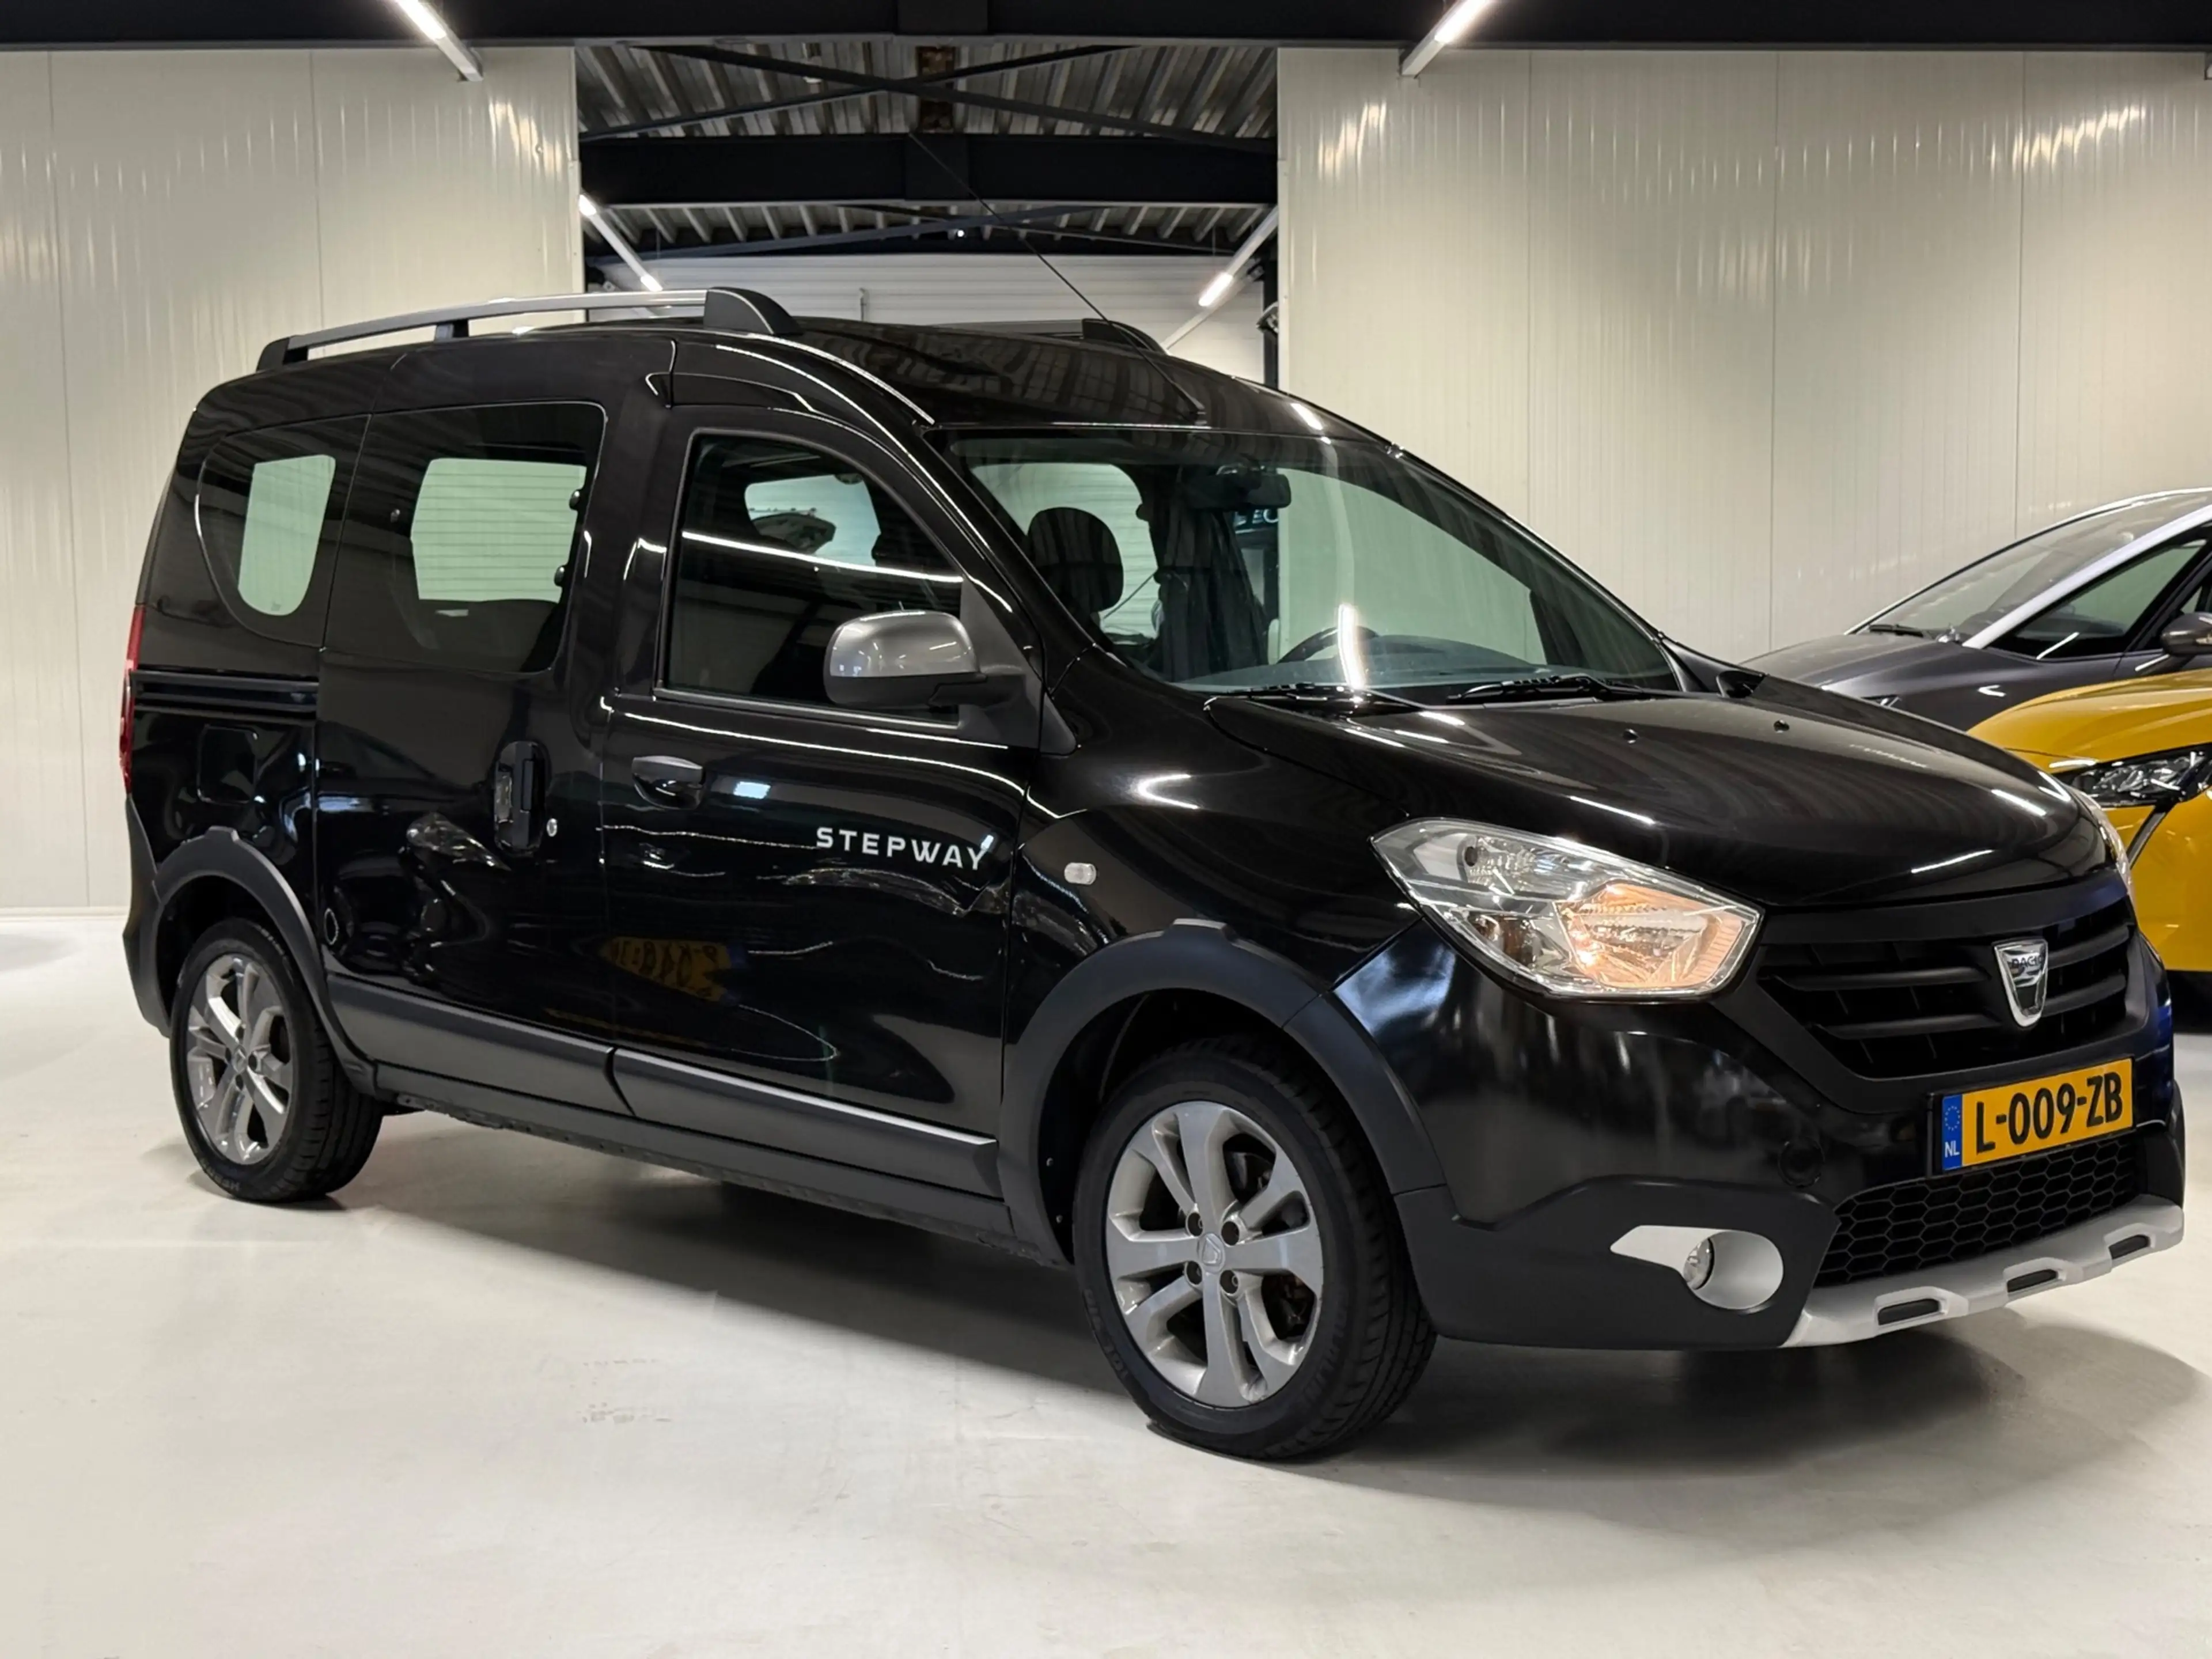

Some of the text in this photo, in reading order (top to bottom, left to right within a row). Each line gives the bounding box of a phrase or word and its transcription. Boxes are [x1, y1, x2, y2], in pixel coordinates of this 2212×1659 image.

[816, 827, 988, 870] STEPWAY
[1976, 1071, 2123, 1156] L-009-ZB
[1944, 1140, 1960, 1158] NL
